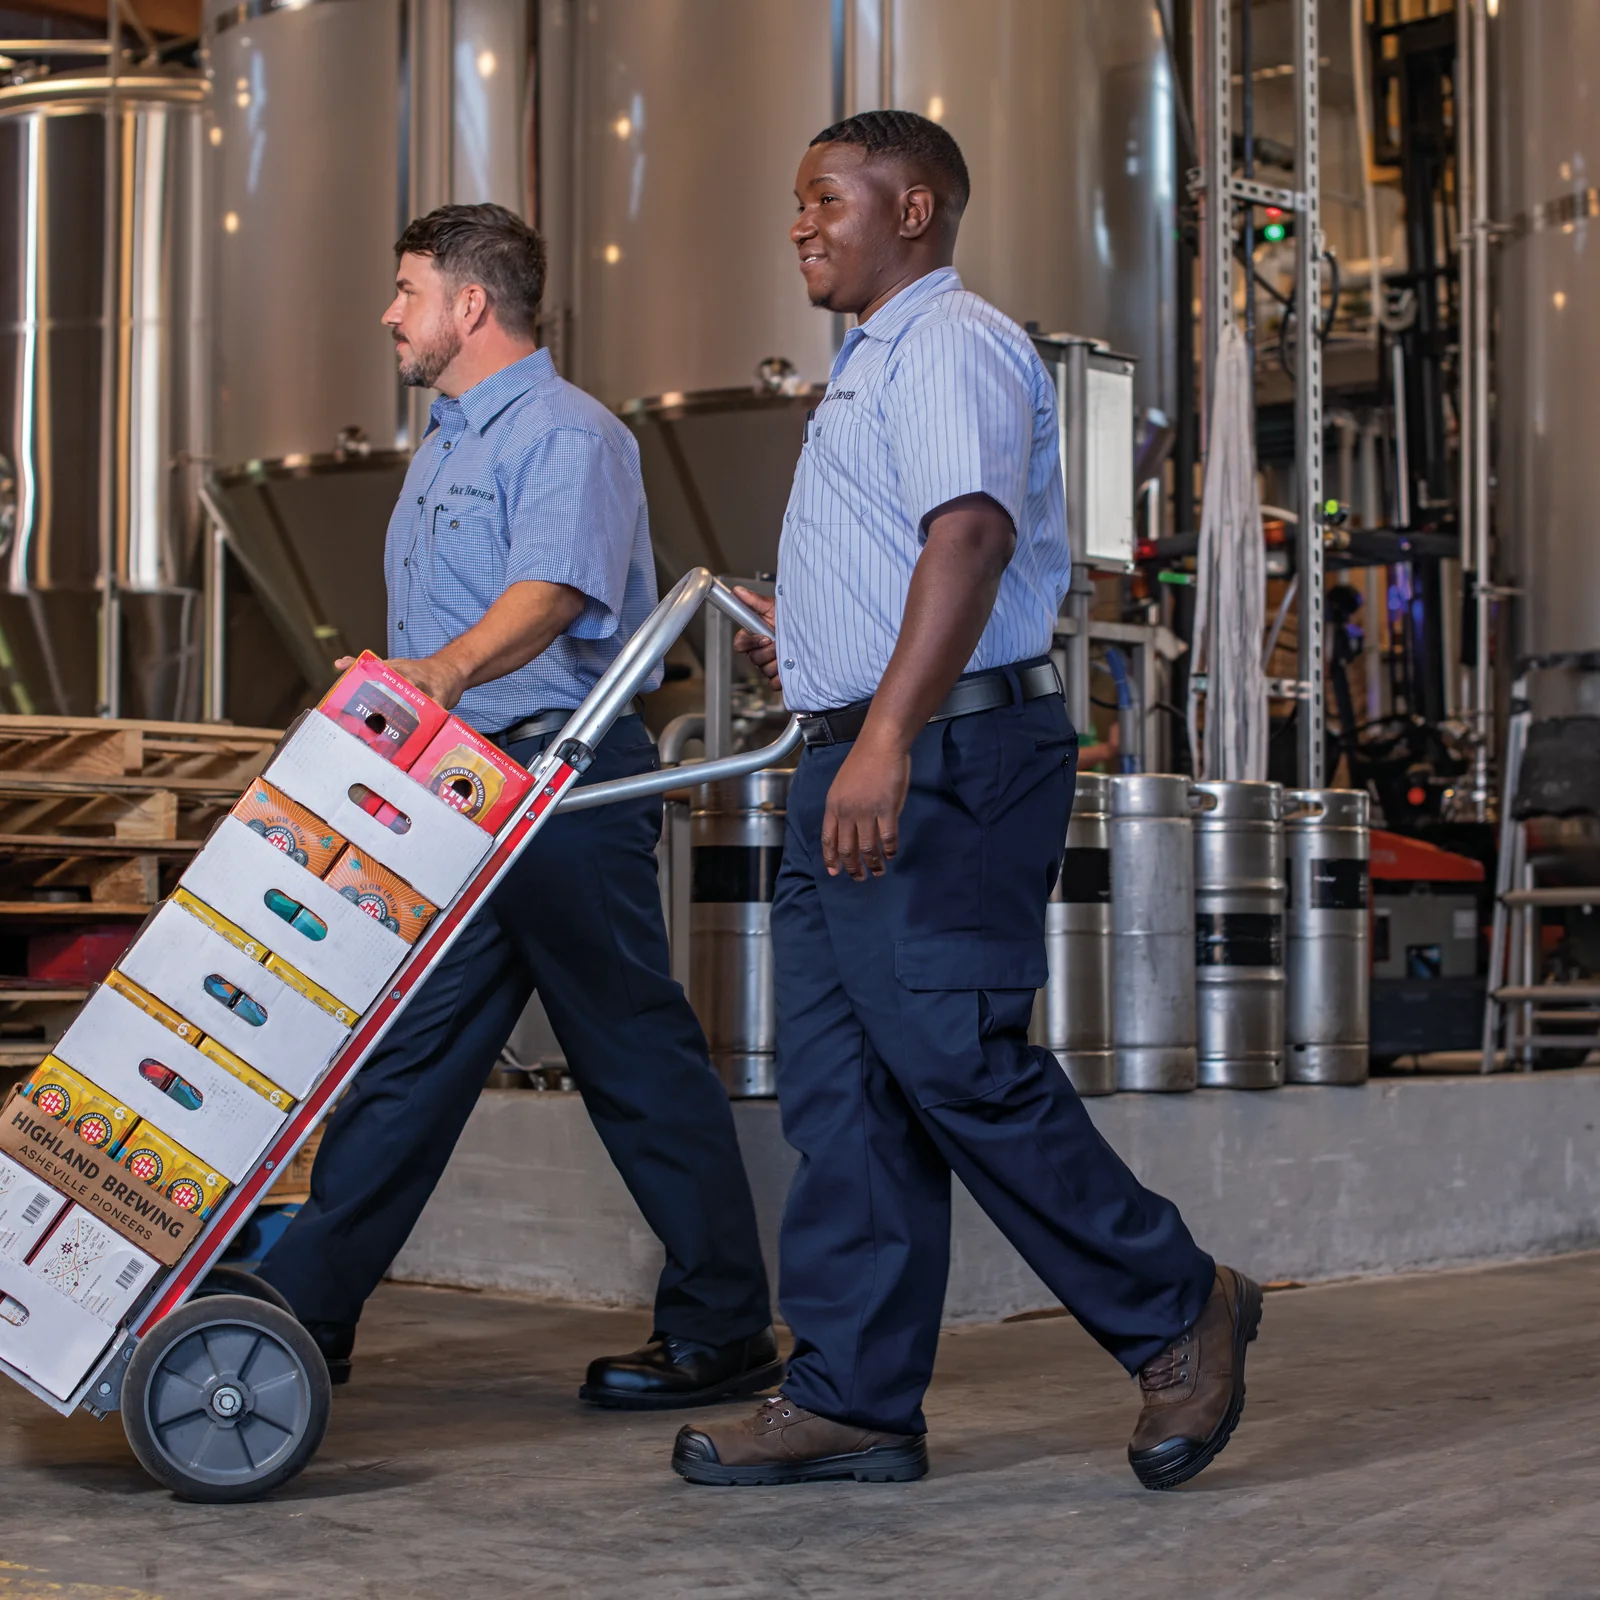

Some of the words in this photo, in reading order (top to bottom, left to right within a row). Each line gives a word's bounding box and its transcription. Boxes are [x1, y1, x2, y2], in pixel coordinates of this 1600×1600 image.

[453, 722, 487, 750] INDEPENDENT
[490, 751, 508, 766] FAMILY
[508, 765, 527, 782] OWNED
[440, 768, 474, 780] HIGHLAND
[473, 776, 484, 808] BREWING
[266, 816, 289, 824] SLOW
[290, 822, 306, 846] CRUSH
[360, 883, 382, 892] SLOW
[383, 890, 398, 914] CRUSH
[38, 1084, 62, 1093] HIGHLAND
[61, 1088, 70, 1110] BREWING
[80, 1113, 103, 1122] HIGHLAND
[103, 1116, 112, 1140] BREWING
[11, 1111, 100, 1180] HIGHLAND
[101, 1174, 185, 1239] BREWING
[132, 1150, 154, 1158] HIGHLAND
[154, 1154, 162, 1176] BREWING
[18, 1145, 90, 1196] ASHEVILLE
[90, 1192, 153, 1240] PIONEERS
[172, 1178, 196, 1187] HIGHLAND
[194, 1182, 203, 1205] BREWING
